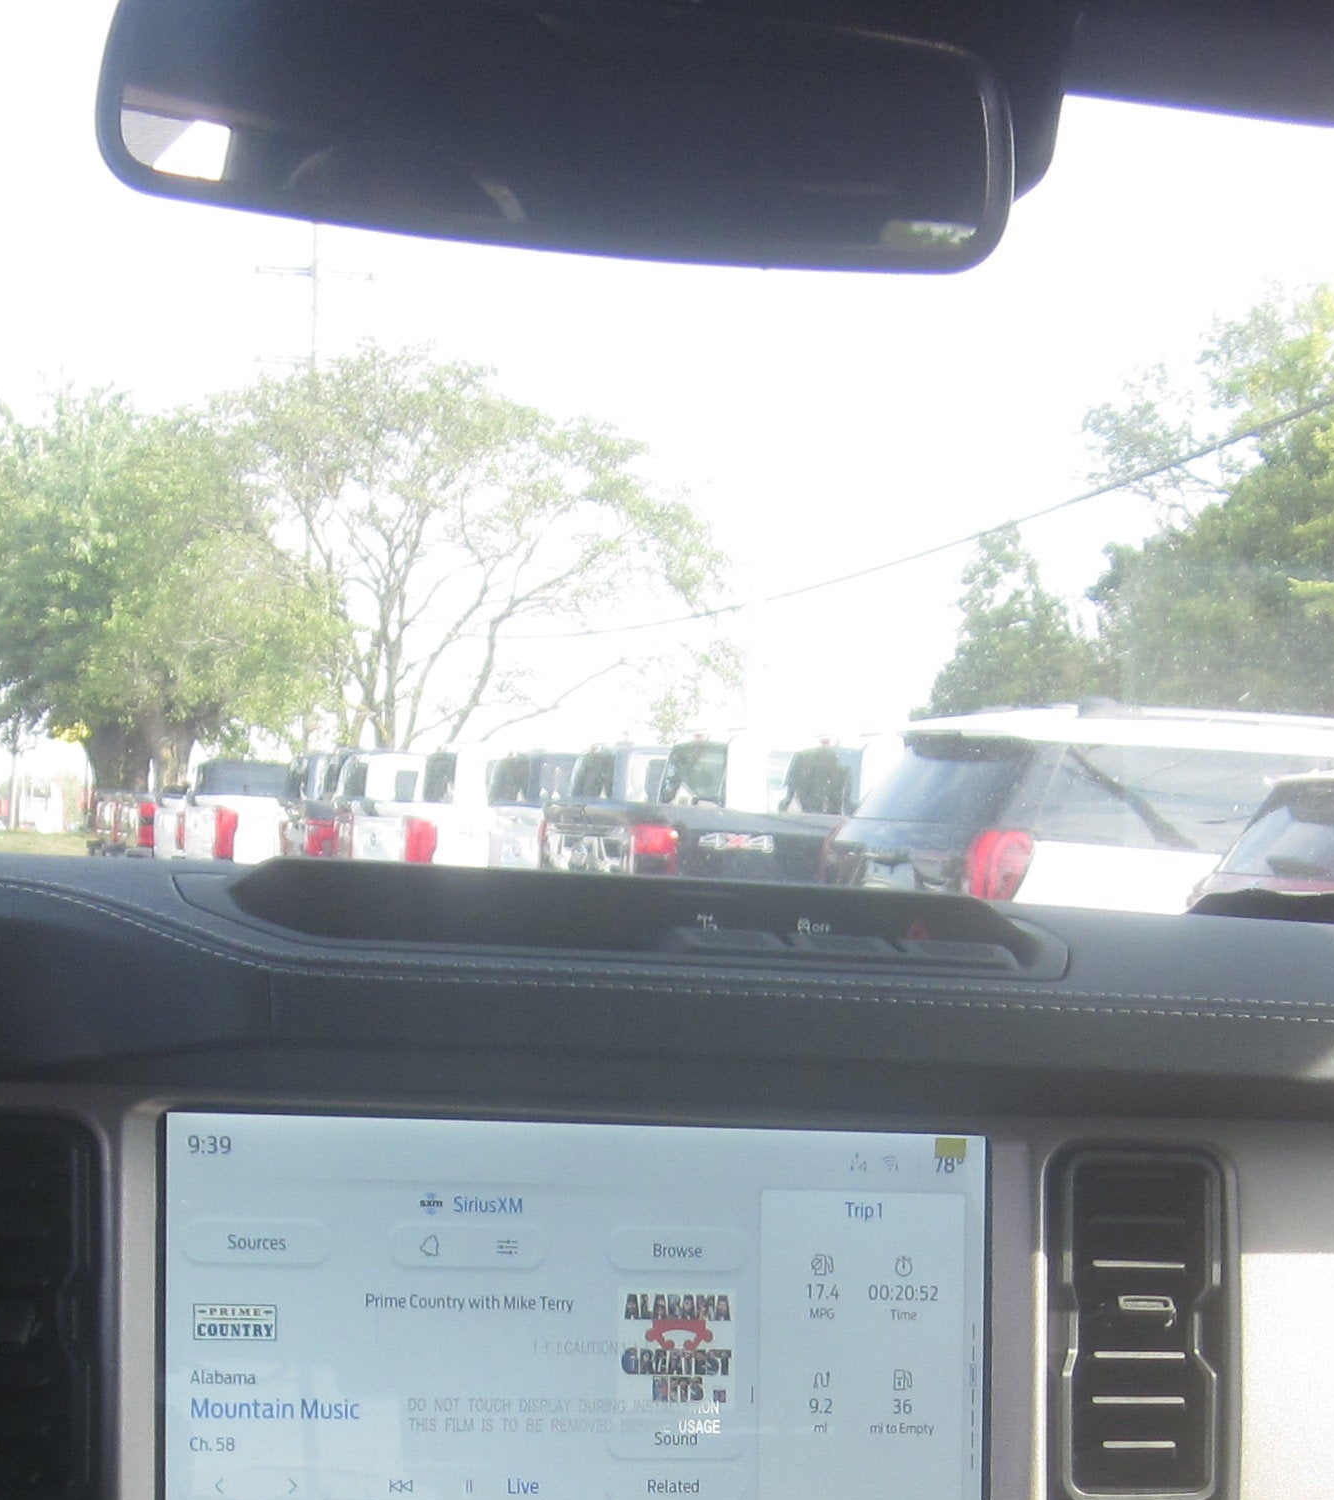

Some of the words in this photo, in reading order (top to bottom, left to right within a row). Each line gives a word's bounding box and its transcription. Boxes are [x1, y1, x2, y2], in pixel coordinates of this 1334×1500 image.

[186, 1135, 232, 1155] 9:39
[453, 1196, 523, 1213] SiriusXM
[845, 1202, 873, 1220] Trip
[878, 1203, 883, 1218] 1
[227, 1234, 287, 1251] Sources
[652, 1243, 703, 1259] Browse
[805, 1284, 839, 1300] 17.4
[868, 1285, 939, 1301] 00:20:52
[365, 1294, 406, 1309] Prime
[409, 1294, 464, 1312] Country
[468, 1295, 501, 1309] with
[503, 1295, 536, 1311] Mike
[539, 1296, 574, 1313] Terry
[624, 1293, 731, 1322] ALABAMA
[209, 1307, 262, 1316] PRIME
[809, 1309, 835, 1320] MPG
[890, 1309, 917, 1321] Time
[196, 1323, 274, 1337] COUNTRY
[621, 1348, 732, 1376] GREATEST
[190, 1370, 256, 1385] Alabama
[652, 1377, 704, 1402] HITS
[190, 1398, 295, 1420] Mountain
[300, 1399, 361, 1420] Music
[408, 1398, 426, 1412] DO
[434, 1398, 460, 1412] NOT
[469, 1399, 511, 1412] TOUCH
[519, 1399, 571, 1412] DISPLAY
[809, 1399, 834, 1414] 9.2
[893, 1399, 913, 1414] 36
[409, 1418, 436, 1432] THIS
[445, 1418, 474, 1432] FILM
[481, 1418, 493, 1432] IS
[502, 1418, 517, 1432] TO
[526, 1418, 542, 1432] BE
[678, 1419, 721, 1434] USAGE
[886, 1424, 897, 1434] to
[899, 1423, 934, 1436] Empty
[189, 1437, 212, 1451] Ch.
[216, 1437, 236, 1451] 58
[654, 1431, 698, 1446] Sound
[507, 1479, 540, 1494] Live
[647, 1479, 700, 1494] Related
